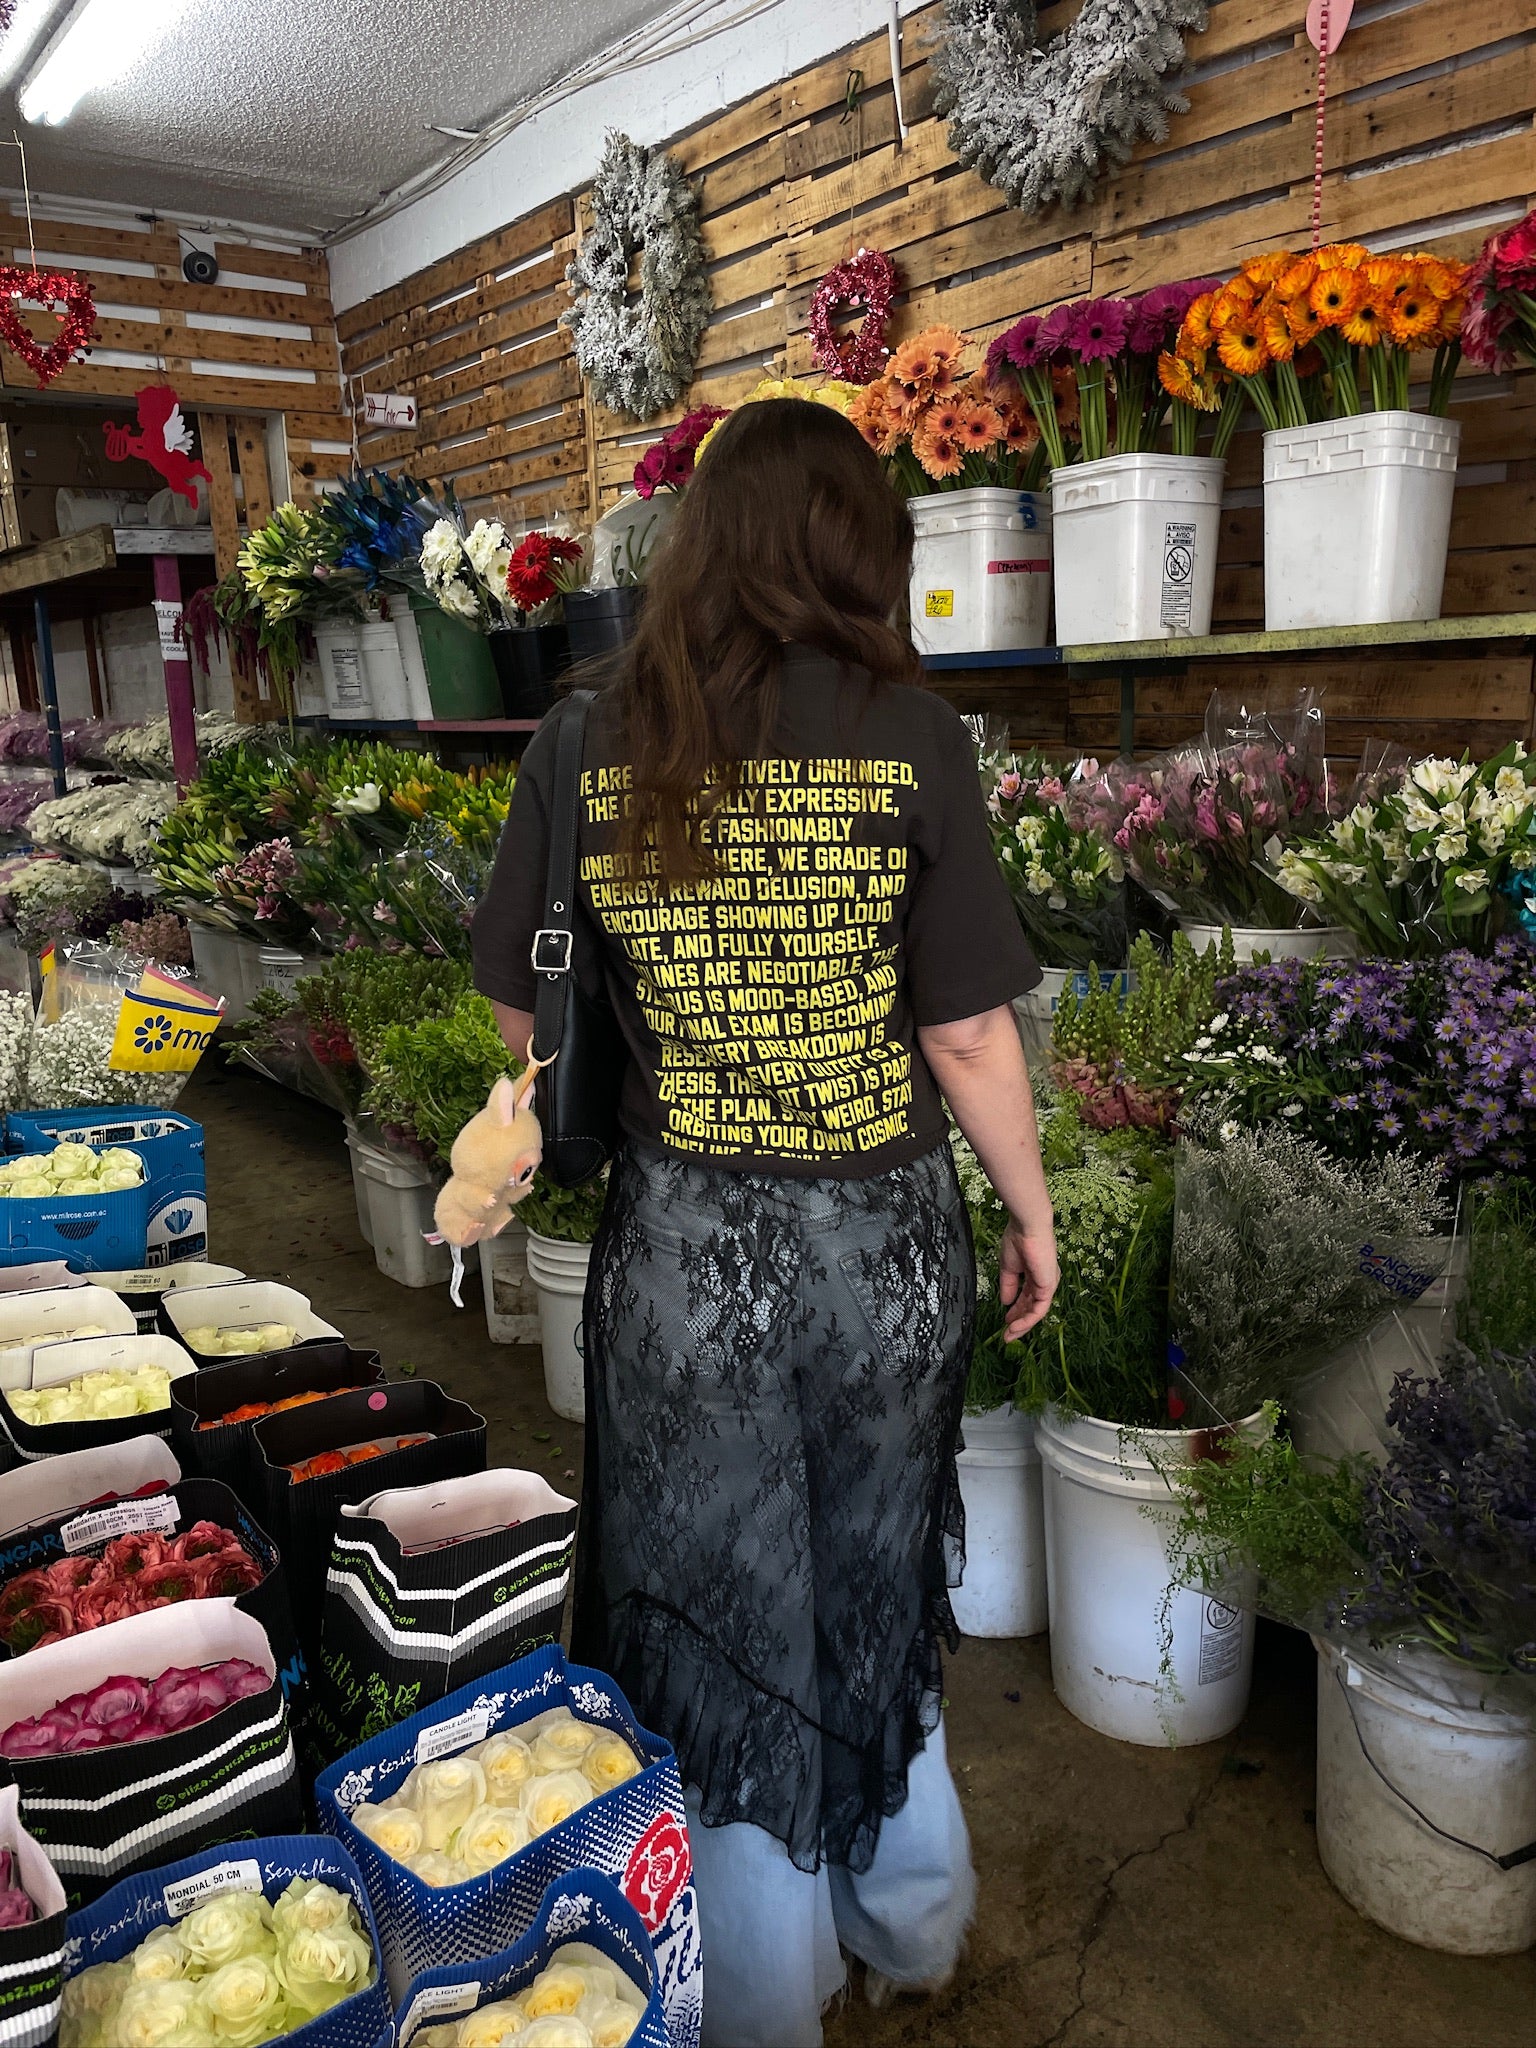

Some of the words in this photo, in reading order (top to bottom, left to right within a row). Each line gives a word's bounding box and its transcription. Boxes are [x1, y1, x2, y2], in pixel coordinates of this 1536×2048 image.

[598, 764, 633, 793] ARE
[808, 759, 919, 791] UNHINGED,
[586, 795, 620, 823] THE
[766, 788, 900, 817] EXPRESSIVE,
[718, 817, 854, 844] FASHIONABLY
[777, 847, 810, 871] WE
[814, 846, 882, 871] GRADE
[887, 847, 908, 870] O
[590, 879, 665, 908] ENERGY,
[669, 877, 751, 903] REWARD
[756, 875, 861, 903] DELUSION,
[866, 874, 907, 899] AND
[601, 905, 711, 934] ENCOURAGE
[715, 904, 808, 930] SHOWING
[812, 902, 839, 928] UP
[622, 936, 669, 964] LATE,
[673, 934, 713, 960] AND
[717, 932, 774, 958] FULLY
[779, 926, 880, 957] YOURSELF.
[703, 960, 743, 986] ARE
[747, 955, 864, 985] NEGOTIABLE,
[869, 943, 900, 967] THE
[705, 989, 726, 1012] IS
[727, 978, 864, 1013] MOOD-BASED,
[863, 964, 898, 996] AND
[727, 1014, 780, 1038] EXAM
[783, 1013, 804, 1036] IS
[808, 990, 897, 1033] BECOMING
[753, 1028, 867, 1060] BREAKDOWN
[870, 1022, 886, 1047] IS
[806, 1053, 868, 1078] OUTFIT
[886, 1041, 905, 1054] A
[725, 1071, 762, 1095] THE
[804, 1073, 858, 1107] TWIST
[860, 1067, 881, 1092] IS
[880, 1052, 912, 1086] PART
[680, 1098, 717, 1121] THE
[721, 1098, 778, 1122] PLAN.
[821, 1095, 880, 1130] WEIRD.
[881, 1079, 913, 1113] STAY
[668, 1108, 754, 1144] ORBITING
[757, 1124, 808, 1150] YOUR
[812, 1129, 856, 1152] OWN
[856, 1110, 909, 1152] COSMIC
[429, 1722, 456, 1737] CANDLE
[457, 1714, 478, 1727] LIGHT
[167, 1881, 212, 1902] MONDIAL
[213, 1873, 225, 1885] 50
[227, 1868, 242, 1881] CM
